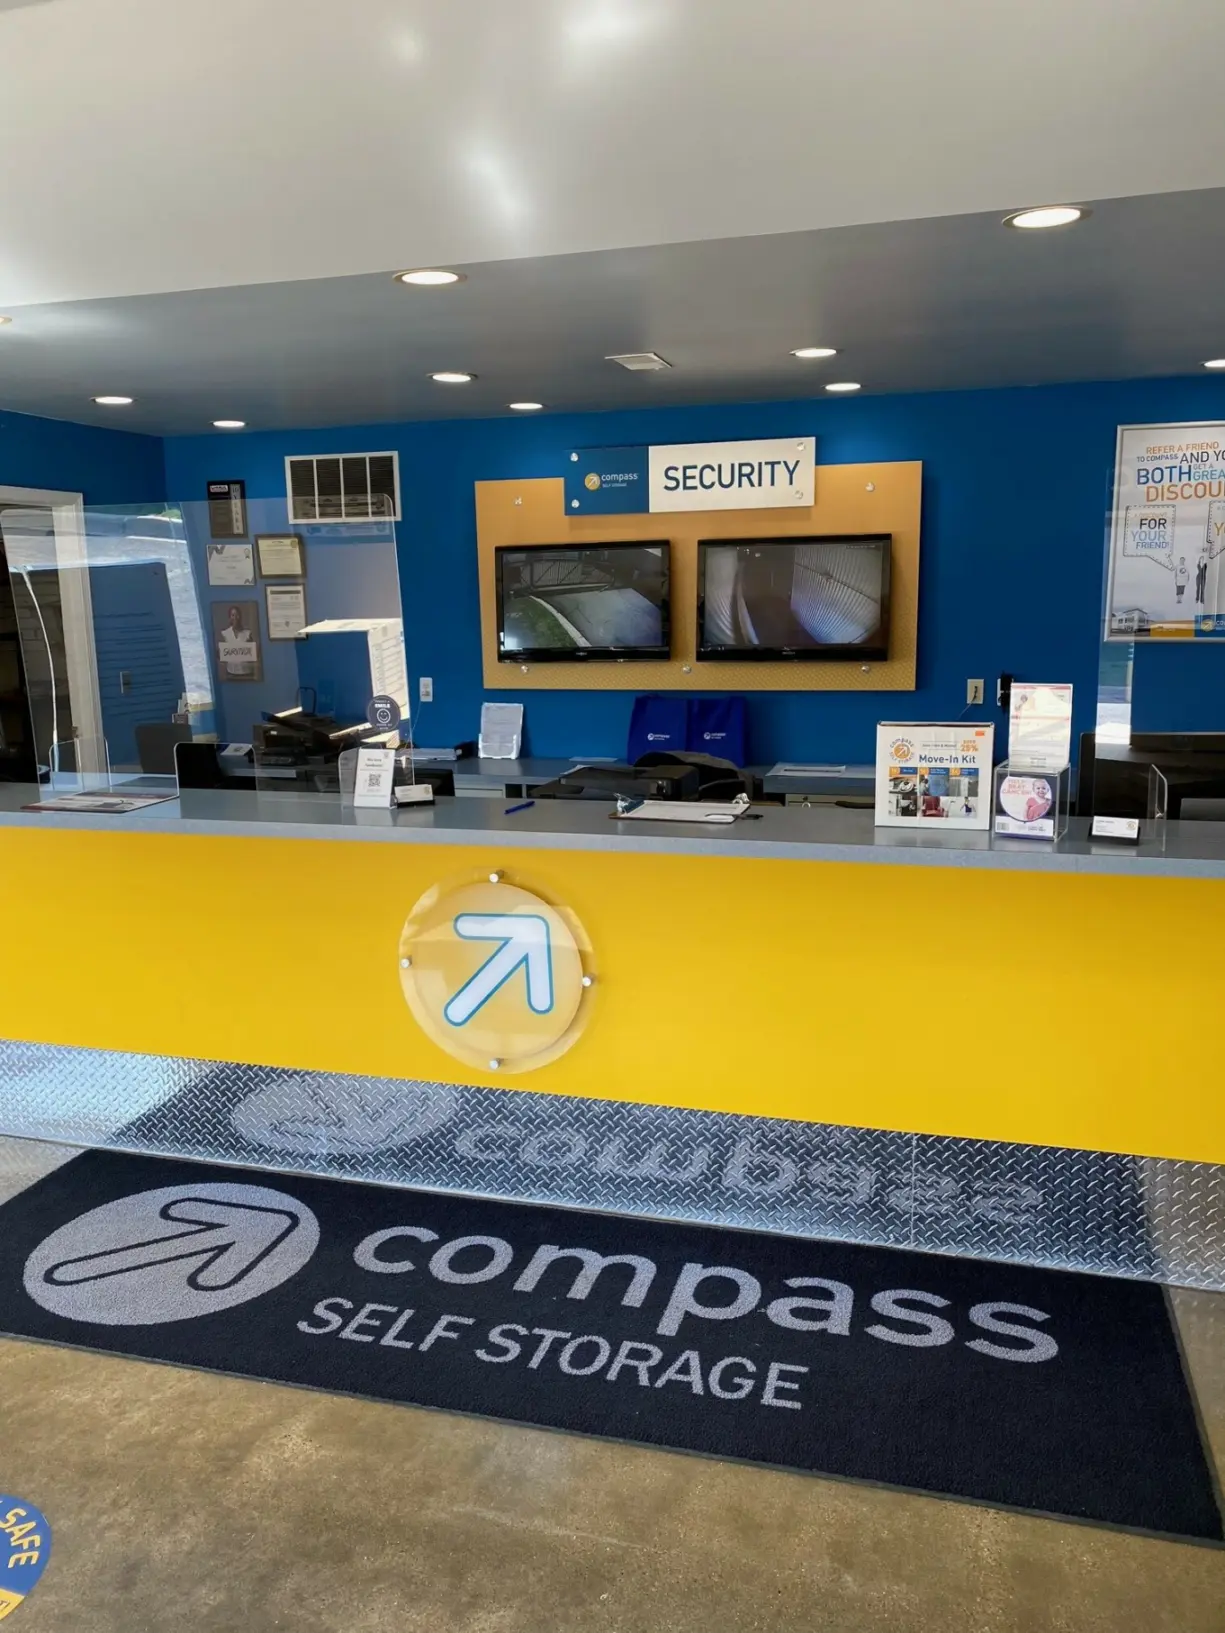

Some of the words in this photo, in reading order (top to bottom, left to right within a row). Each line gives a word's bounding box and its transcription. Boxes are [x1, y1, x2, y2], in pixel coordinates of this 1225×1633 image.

[1146, 446, 1175, 454] REFER
[1186, 441, 1219, 451] FRIEND
[1180, 451, 1209, 464] AND
[601, 473, 638, 482] compass
[664, 460, 800, 491] SECURITY
[1137, 465, 1191, 485] BOTH
[1146, 481, 1225, 502] DISCOU
[1140, 518, 1167, 529] FOR
[1131, 530, 1166, 541] YOUR
[919, 754, 959, 763] Move-In
[961, 755, 976, 763] Kit
[353, 1226, 1059, 1363] compass
[296, 1297, 476, 1352] SELF
[475, 1323, 809, 1410] STORAGE
[0, 1508, 41, 1568] SAFE
